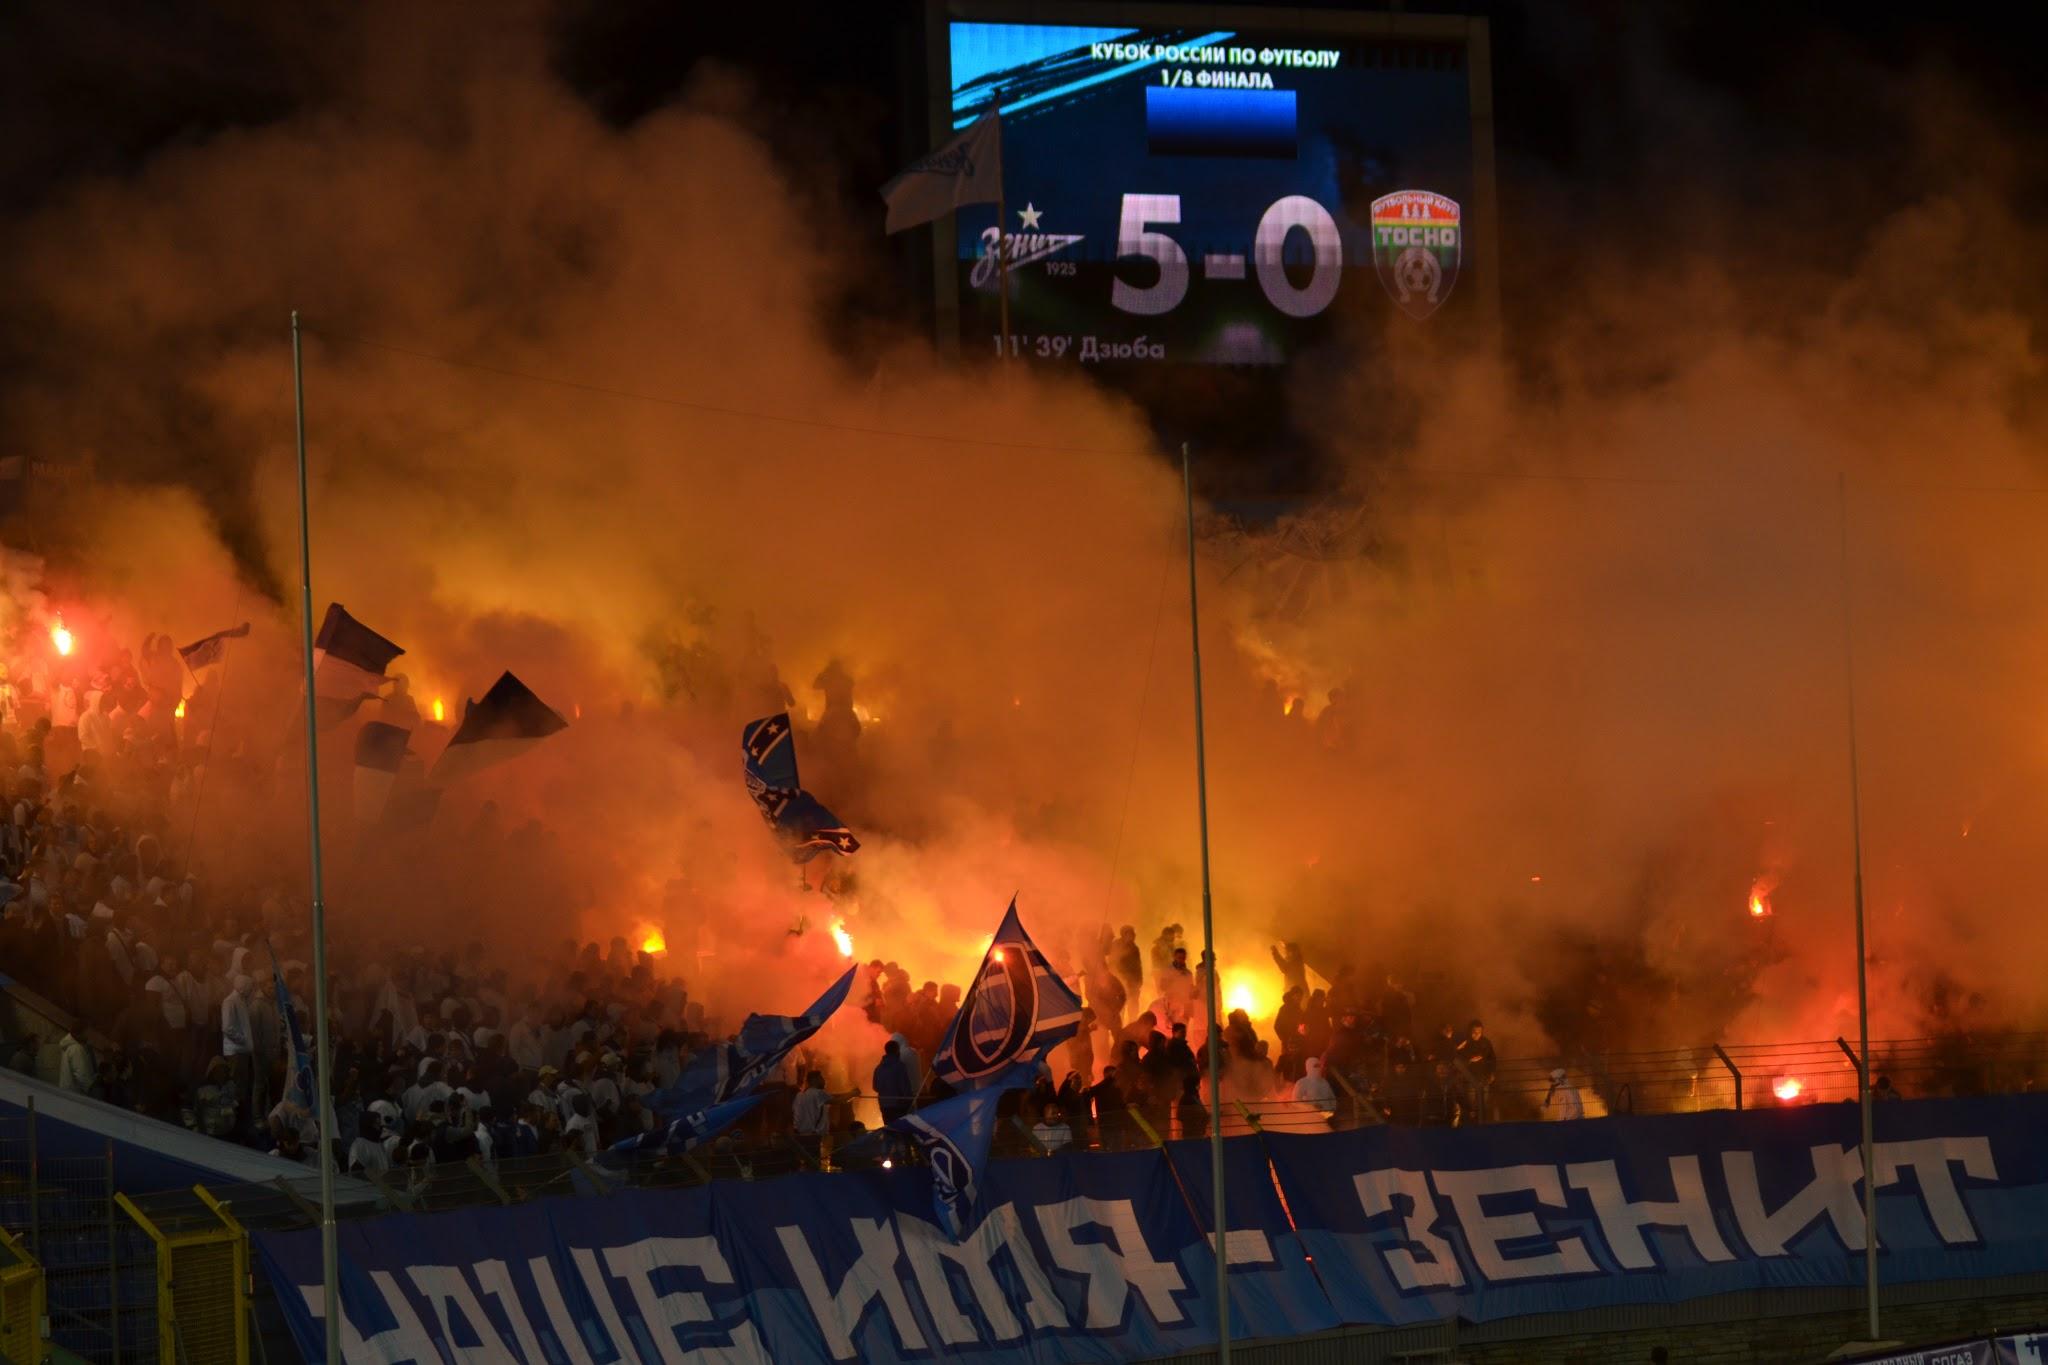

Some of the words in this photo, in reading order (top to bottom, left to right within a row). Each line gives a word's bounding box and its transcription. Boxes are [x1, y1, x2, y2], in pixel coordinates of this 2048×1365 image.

[1091, 43, 1150, 61] КУБОК
[1155, 45, 1225, 64] РОССИИ
[1229, 47, 1256, 65] ПО
[1259, 48, 1340, 68] ФУТБОЛУ
[1161, 69, 1193, 88] 1/8
[1197, 70, 1274, 89] ФИНАЛА
[1378, 227, 1456, 247] ТОСНО
[1046, 262, 1077, 276] 1925
[1036, 335, 1072, 358] 39'
[1079, 335, 1165, 363] Дзюба
[775, 1196, 1188, 1361] ИМЯ
[1353, 1136, 1999, 1290] ЗЕНИТ
